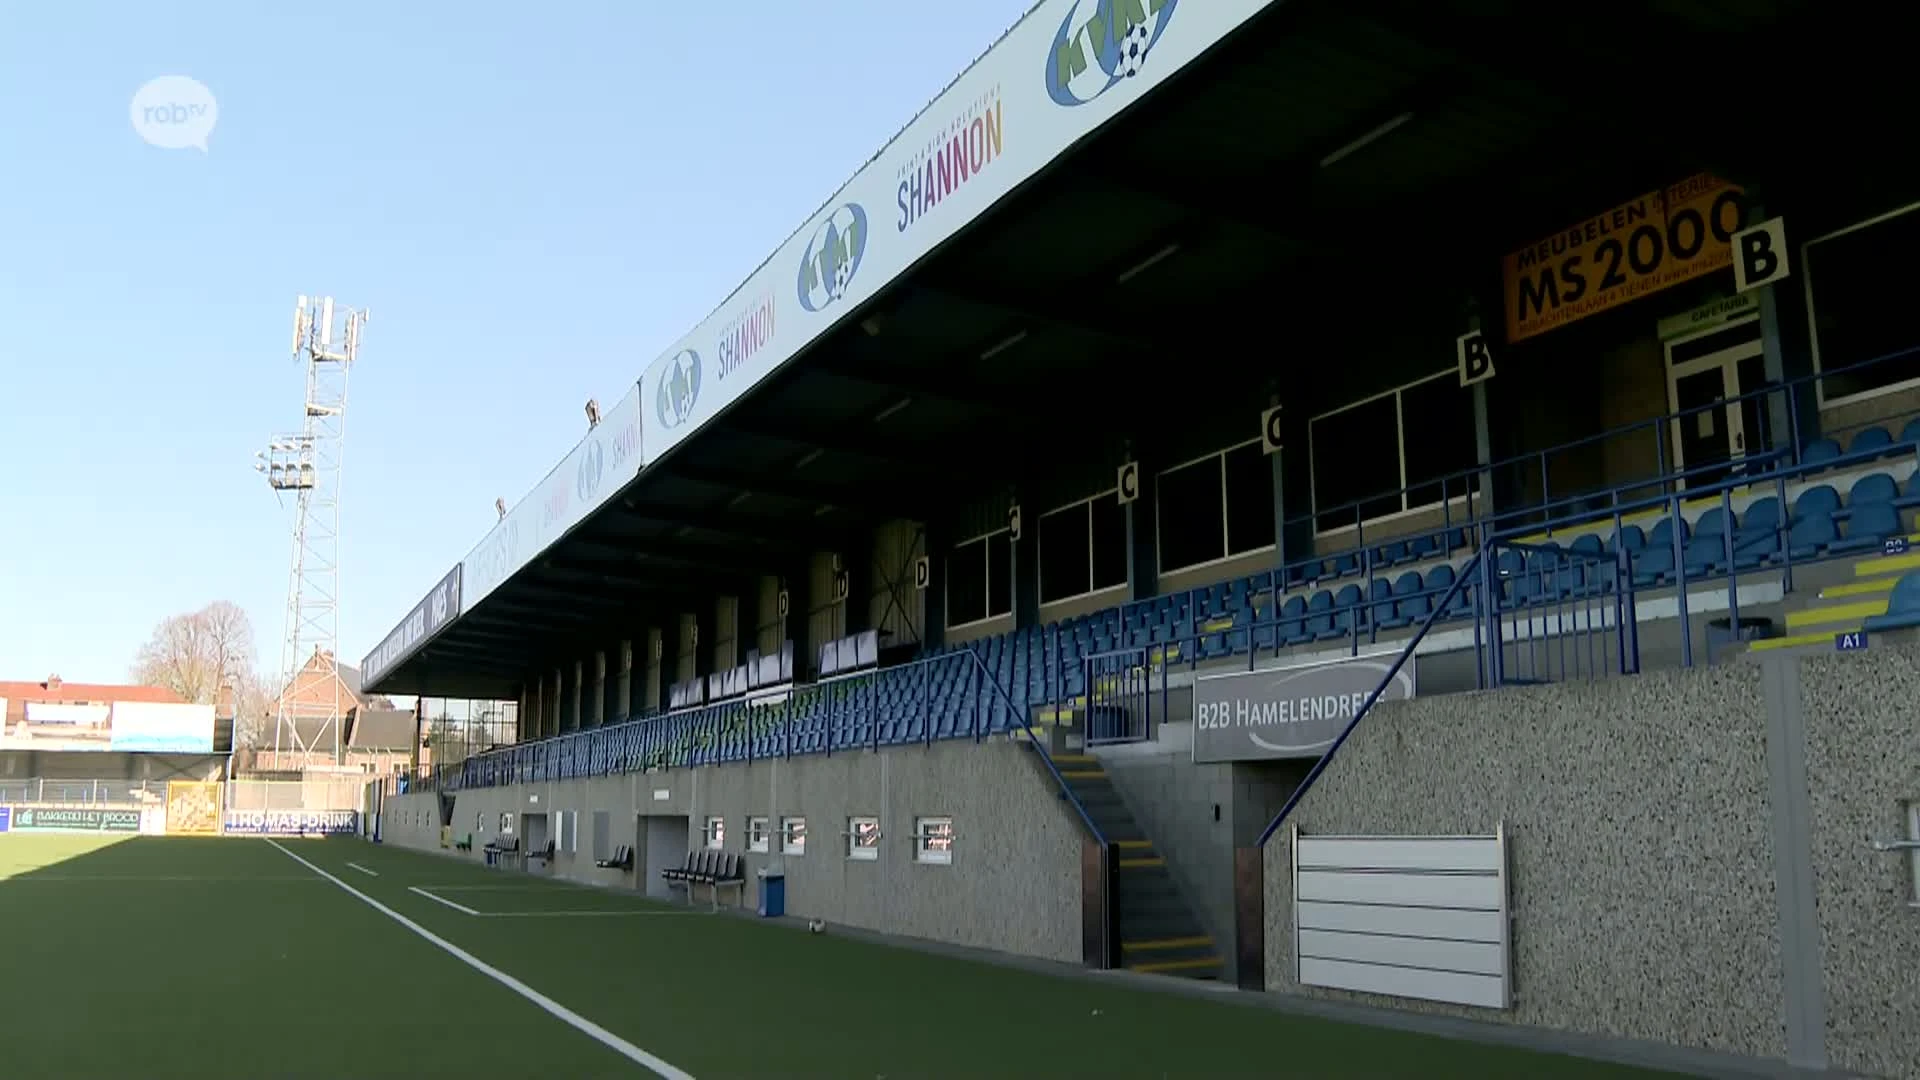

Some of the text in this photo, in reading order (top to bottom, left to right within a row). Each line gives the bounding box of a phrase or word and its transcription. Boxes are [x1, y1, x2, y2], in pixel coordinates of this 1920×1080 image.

[1056, 0, 1170, 89] KVK
[897, 96, 1003, 233] SHANNON
[1518, 200, 1647, 272] MEUBELEN
[1518, 190, 1745, 321] MS 2000
[1741, 229, 1778, 283] B
[718, 293, 776, 382] SHANNON
[1464, 336, 1490, 380] B
[1122, 466, 1135, 498] C
[1008, 509, 1018, 538] C
[917, 561, 927, 586] D
[1842, 633, 1861, 649] A1
[1198, 702, 1230, 730] B2B
[230, 812, 354, 827] THOMAS-DRINK
